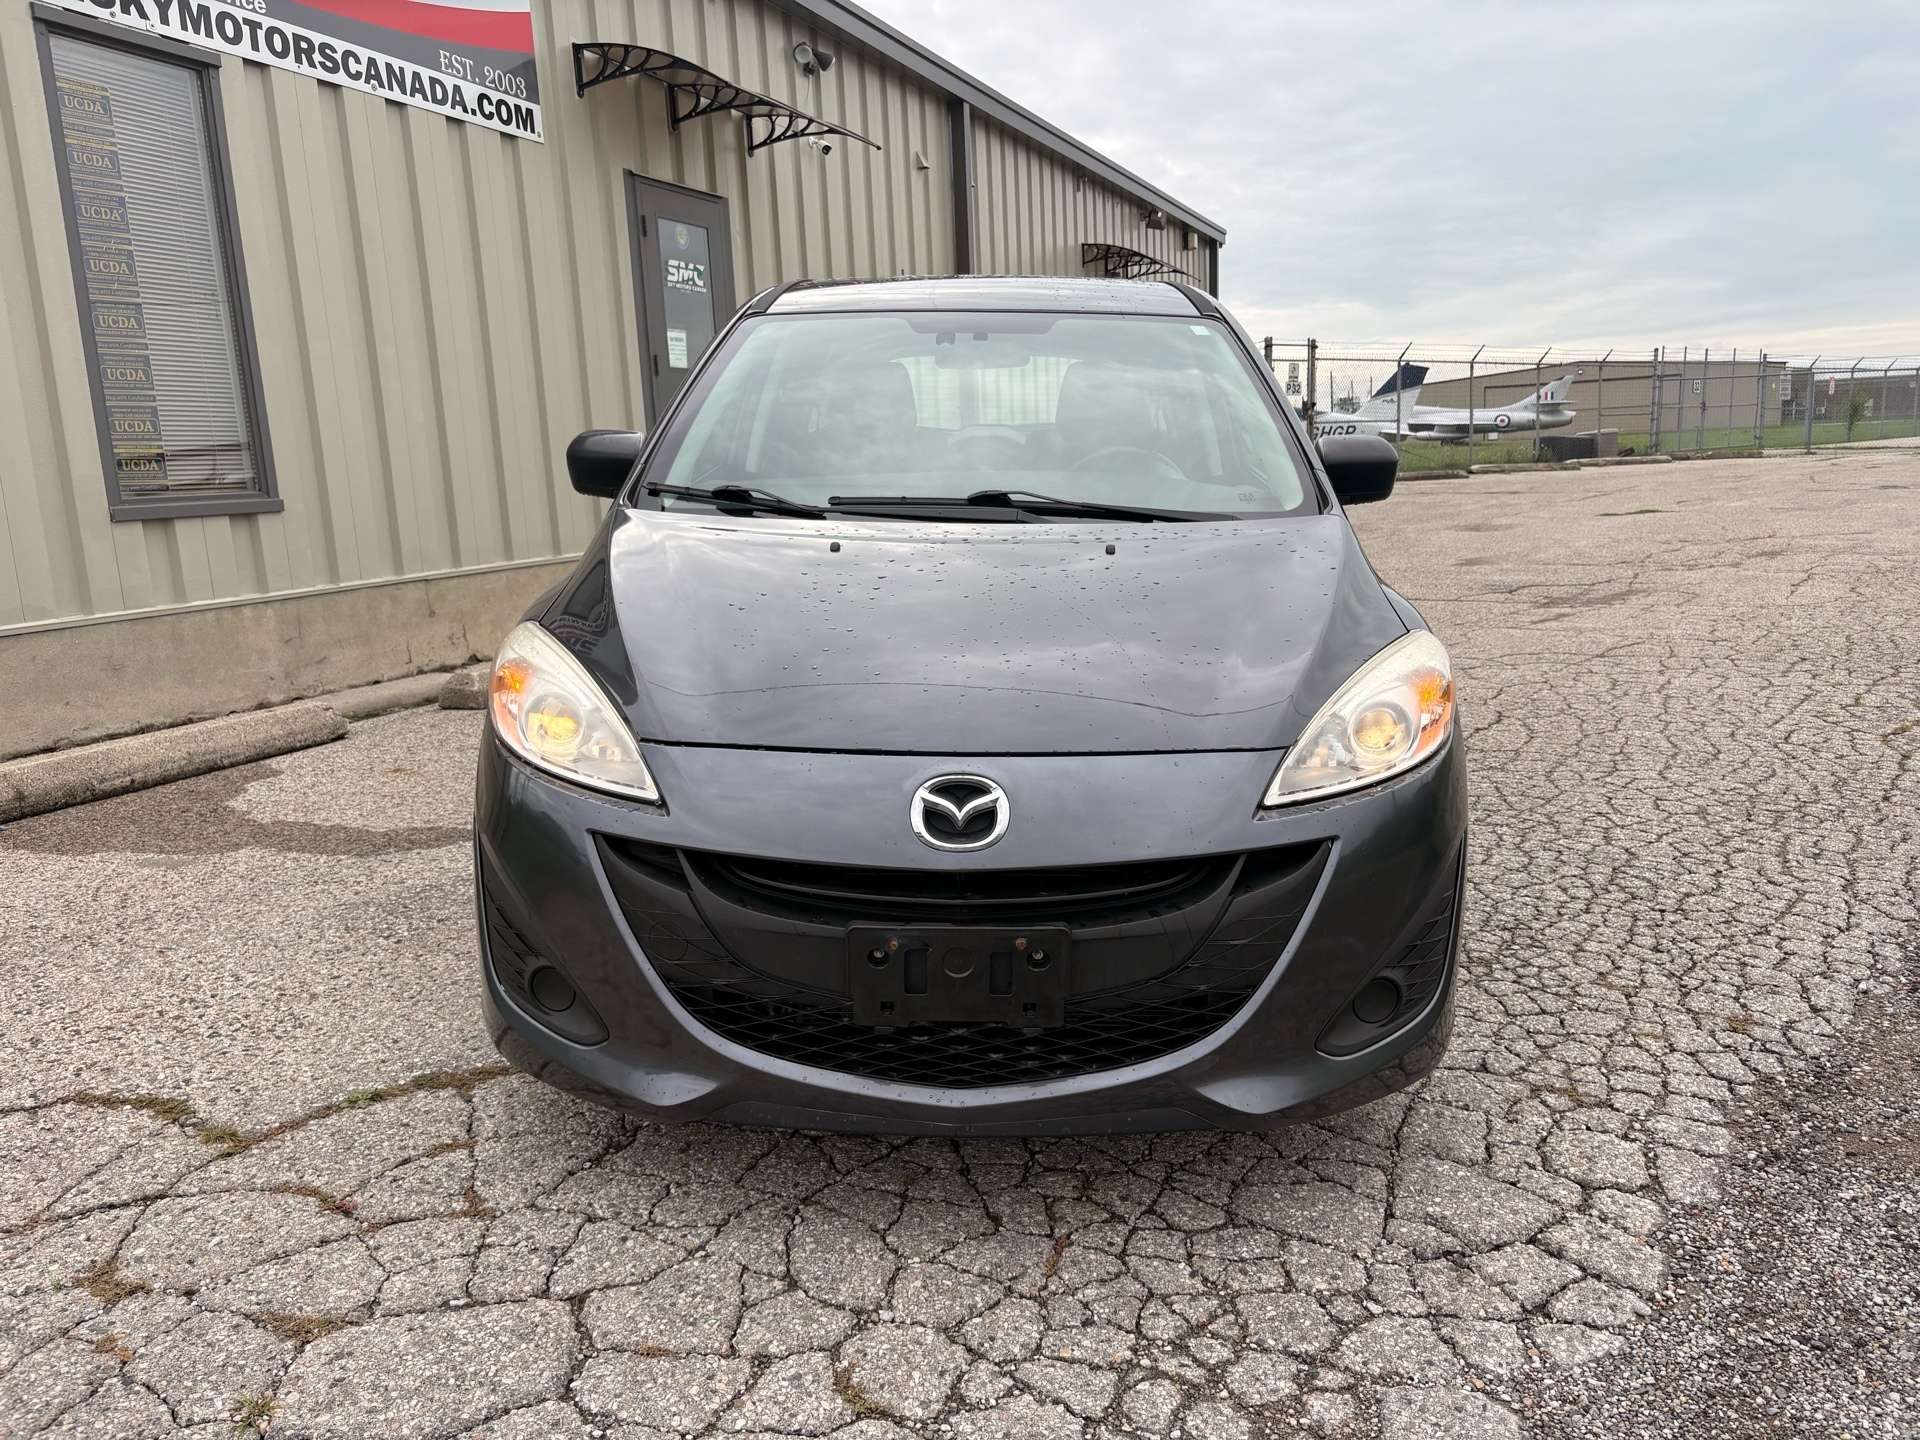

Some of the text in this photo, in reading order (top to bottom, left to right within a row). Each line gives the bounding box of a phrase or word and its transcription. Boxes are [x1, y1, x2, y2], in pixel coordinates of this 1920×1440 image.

[439, 49, 527, 98] EST. 2003
[64, 95, 104, 113] UCDA
[73, 151, 112, 169] UCDA
[80, 205, 121, 221] UCDA
[90, 259, 130, 274] UCDA
[667, 259, 705, 287] SMC
[98, 315, 138, 329] UCDA
[106, 368, 146, 381] UCDA
[114, 420, 154, 432] UCDA
[120, 459, 159, 471] UCDA
